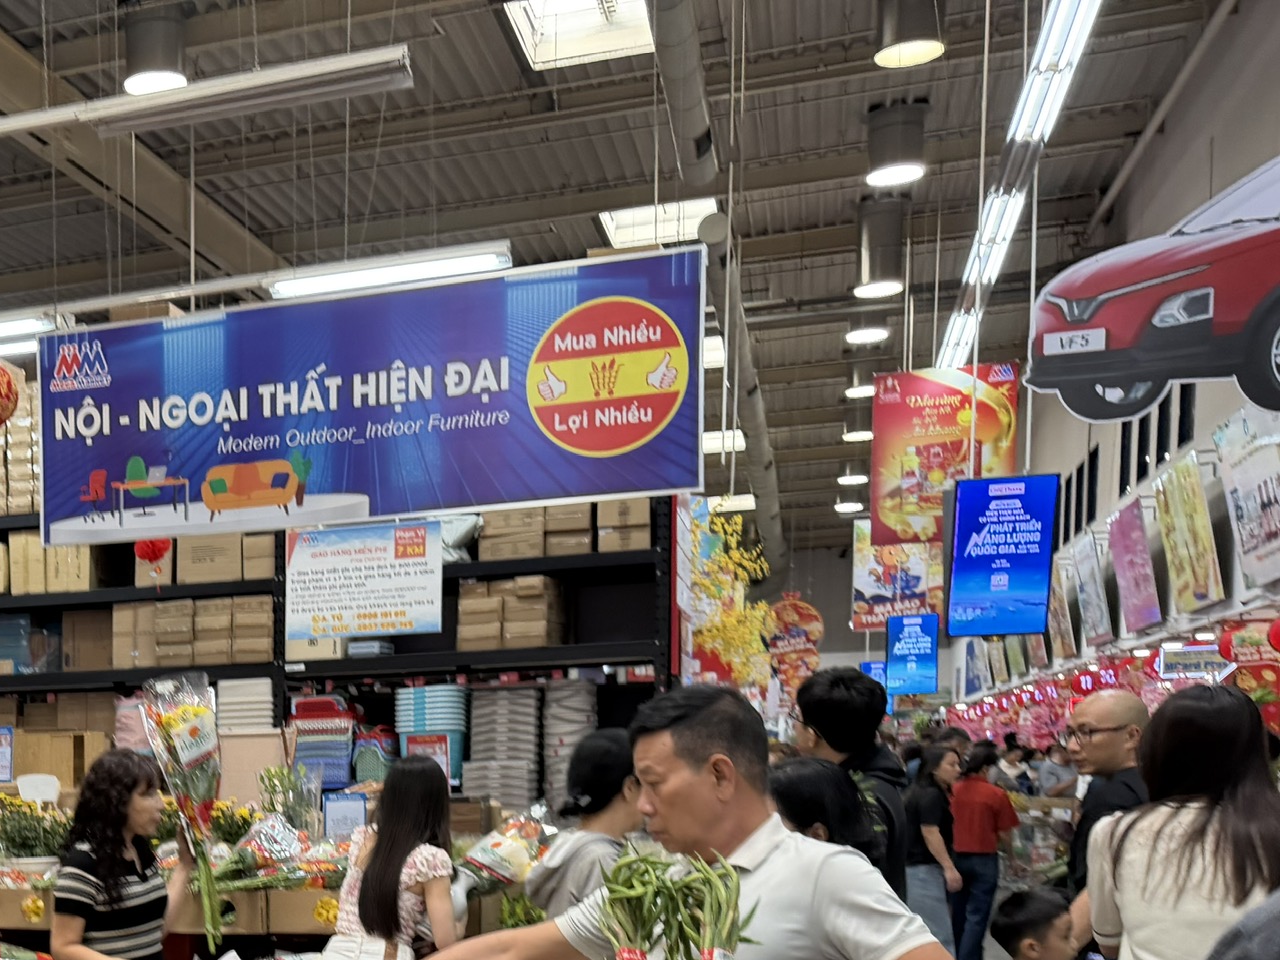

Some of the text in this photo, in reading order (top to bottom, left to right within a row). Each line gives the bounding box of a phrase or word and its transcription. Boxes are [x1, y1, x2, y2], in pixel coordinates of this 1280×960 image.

[554, 319, 662, 353] Mua Nhiều
[54, 394, 111, 446] NỘI
[138, 386, 248, 432] NGOẠI
[258, 362, 342, 419] THẤT
[352, 358, 432, 413] HIỆN
[444, 355, 509, 404] ĐẠI
[554, 400, 652, 434] Lợi Nhiều
[217, 433, 280, 455] Modern
[427, 409, 510, 432] Furniture
